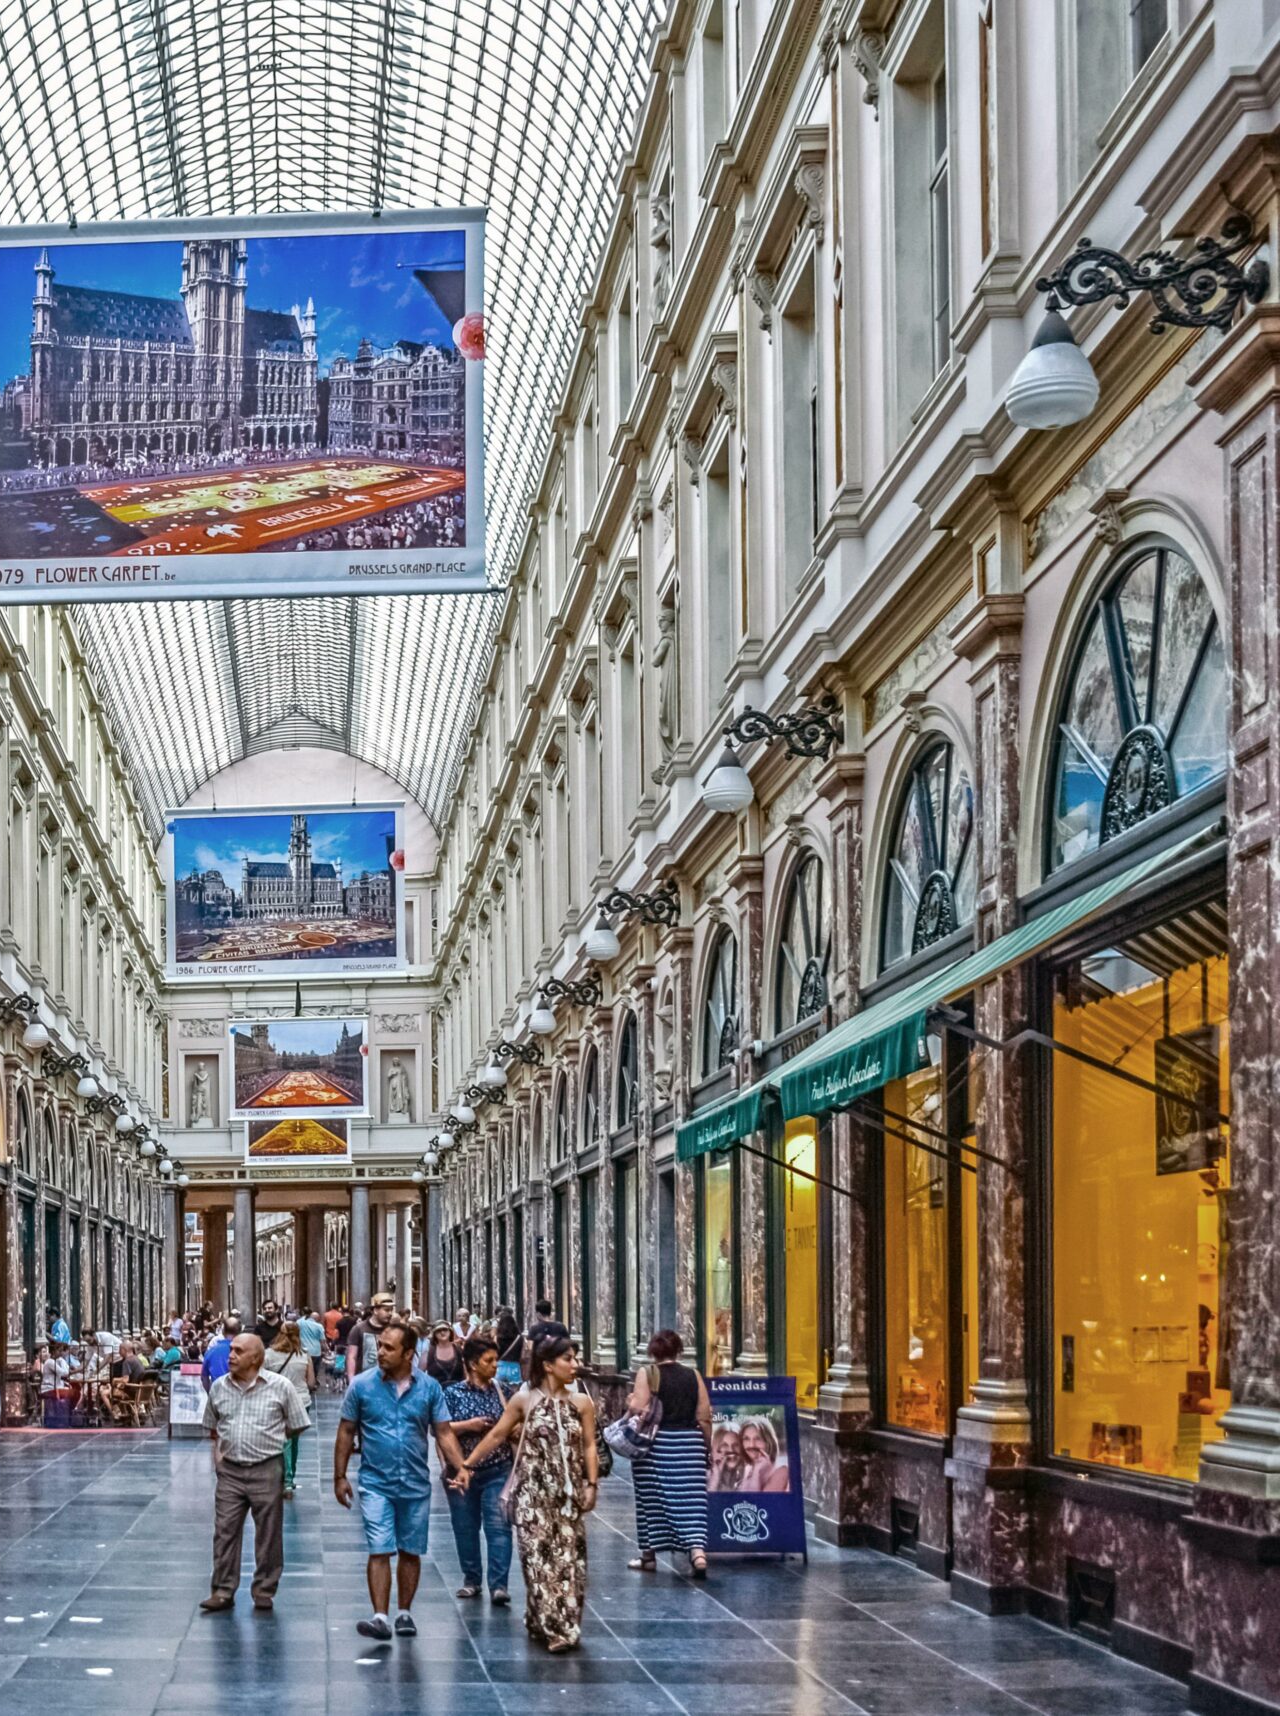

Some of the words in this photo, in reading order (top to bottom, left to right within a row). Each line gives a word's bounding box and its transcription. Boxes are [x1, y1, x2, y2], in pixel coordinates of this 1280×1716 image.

[348, 563, 398, 575] BRUSSELS
[35, 567, 99, 584] FLOWER
[176, 966, 194, 975] 1986
[198, 965, 228, 974] FLOWER
[711, 1380, 767, 1391] Leonidas
